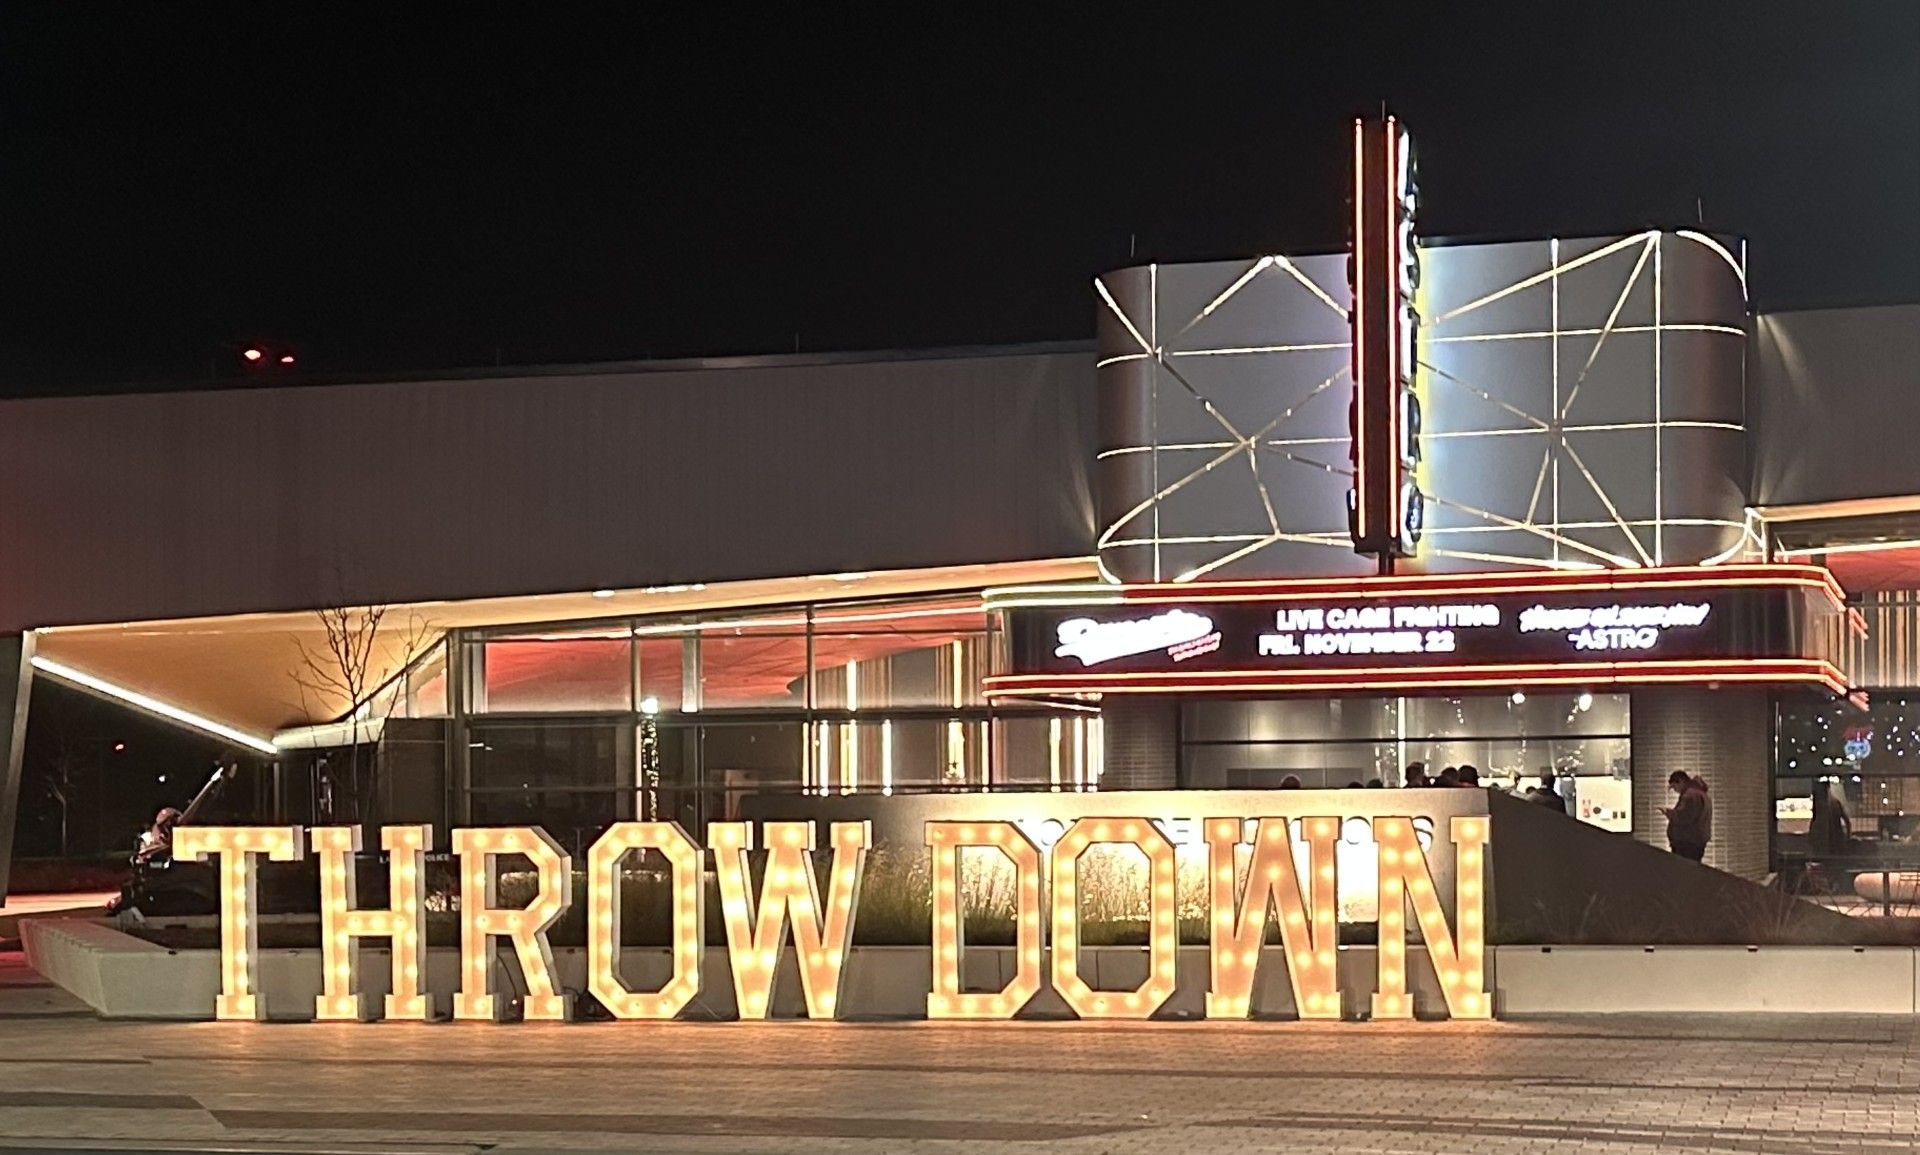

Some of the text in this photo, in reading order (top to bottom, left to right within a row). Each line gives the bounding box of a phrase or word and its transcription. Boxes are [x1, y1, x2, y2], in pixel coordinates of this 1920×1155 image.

[1276, 609, 1324, 631] LIVE
[1326, 607, 1390, 630] CAGE
[1393, 604, 1500, 628] FIGHTING
[1303, 632, 1425, 655] NOVEMBER
[172, 815, 1492, 1021] THROW DOWN
